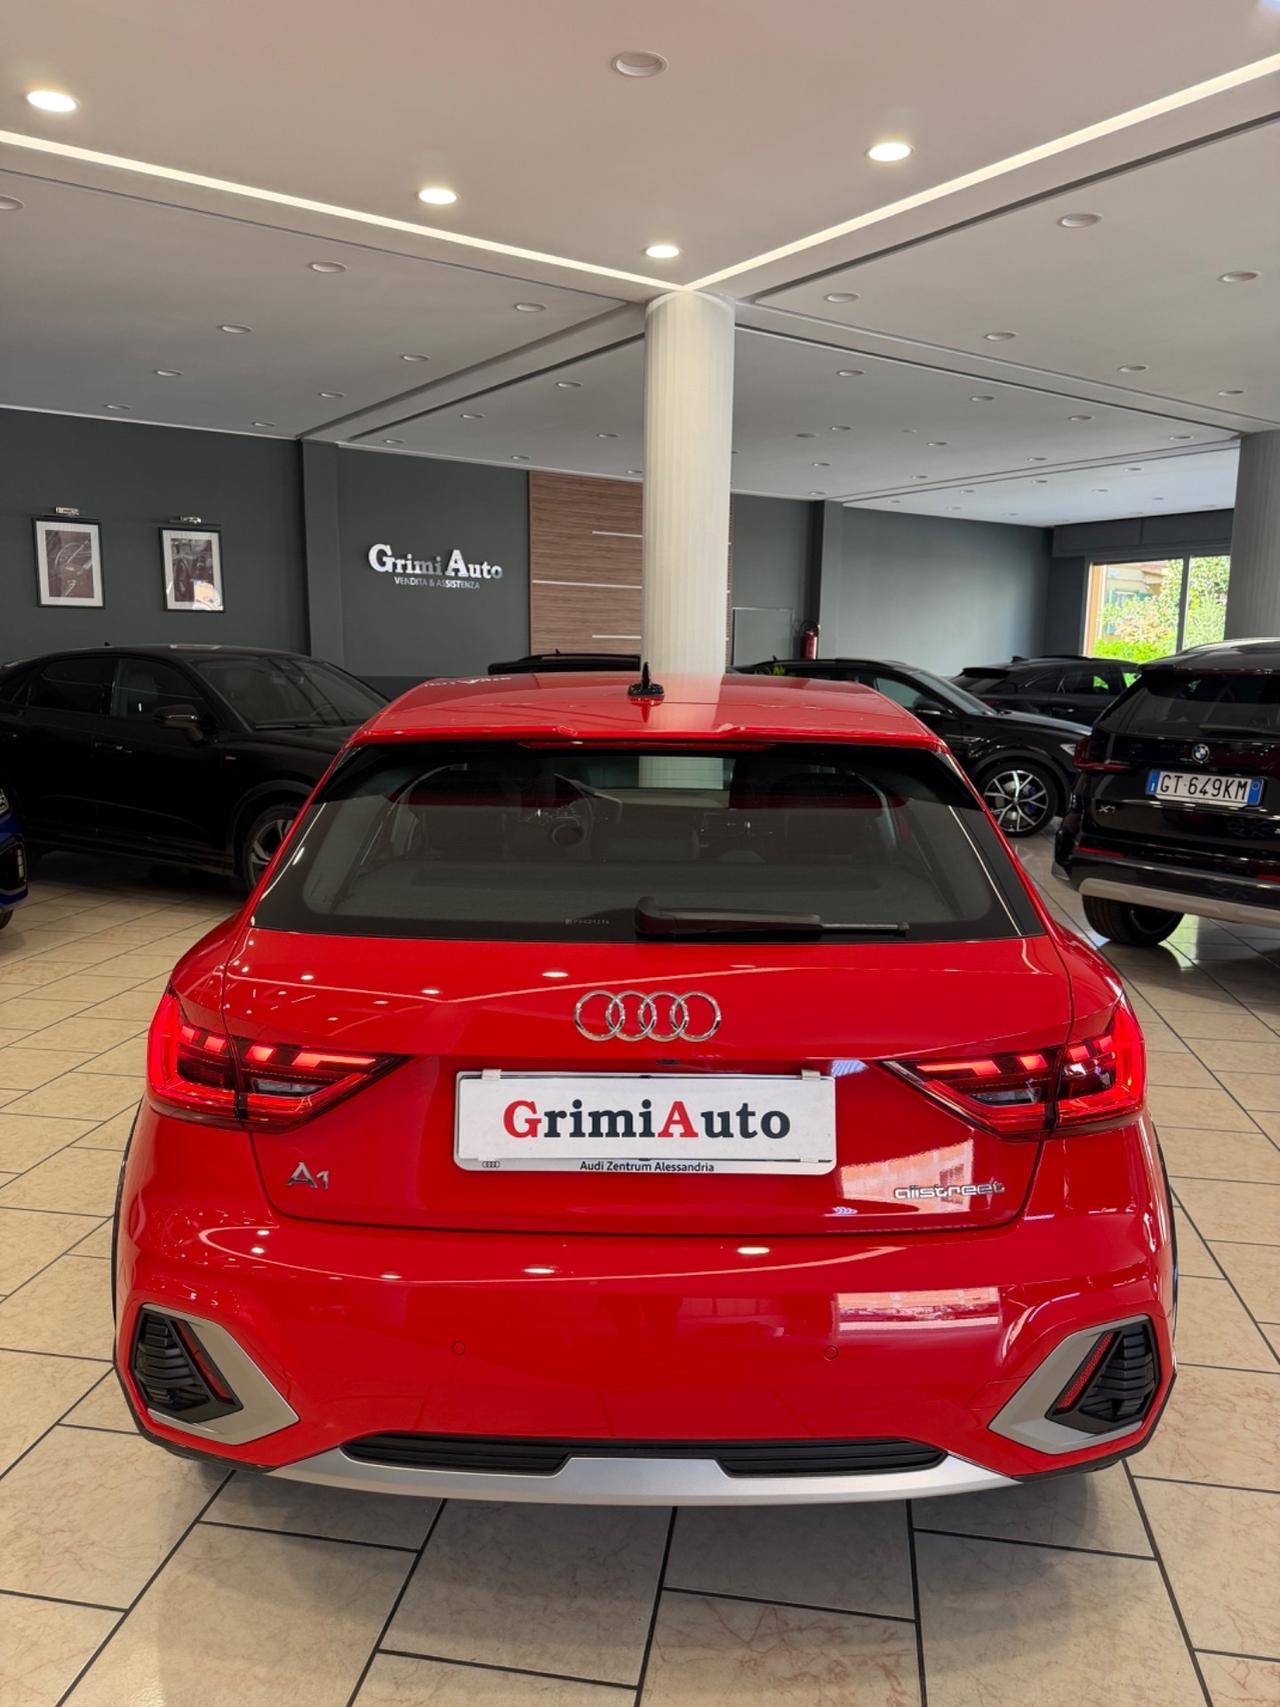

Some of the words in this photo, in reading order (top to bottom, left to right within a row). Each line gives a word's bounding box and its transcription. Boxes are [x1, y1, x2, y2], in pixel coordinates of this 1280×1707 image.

[393, 576, 428, 587] VENDITA
[429, 578, 435, 587] &
[436, 579, 480, 589] ASSISTENZA
[503, 1099, 791, 1139] GrimiAuto
[287, 1161, 329, 1190] A1
[579, 1160, 605, 1171] Audi
[606, 1160, 652, 1172] Zentrum
[654, 1161, 715, 1173] Alessandria
